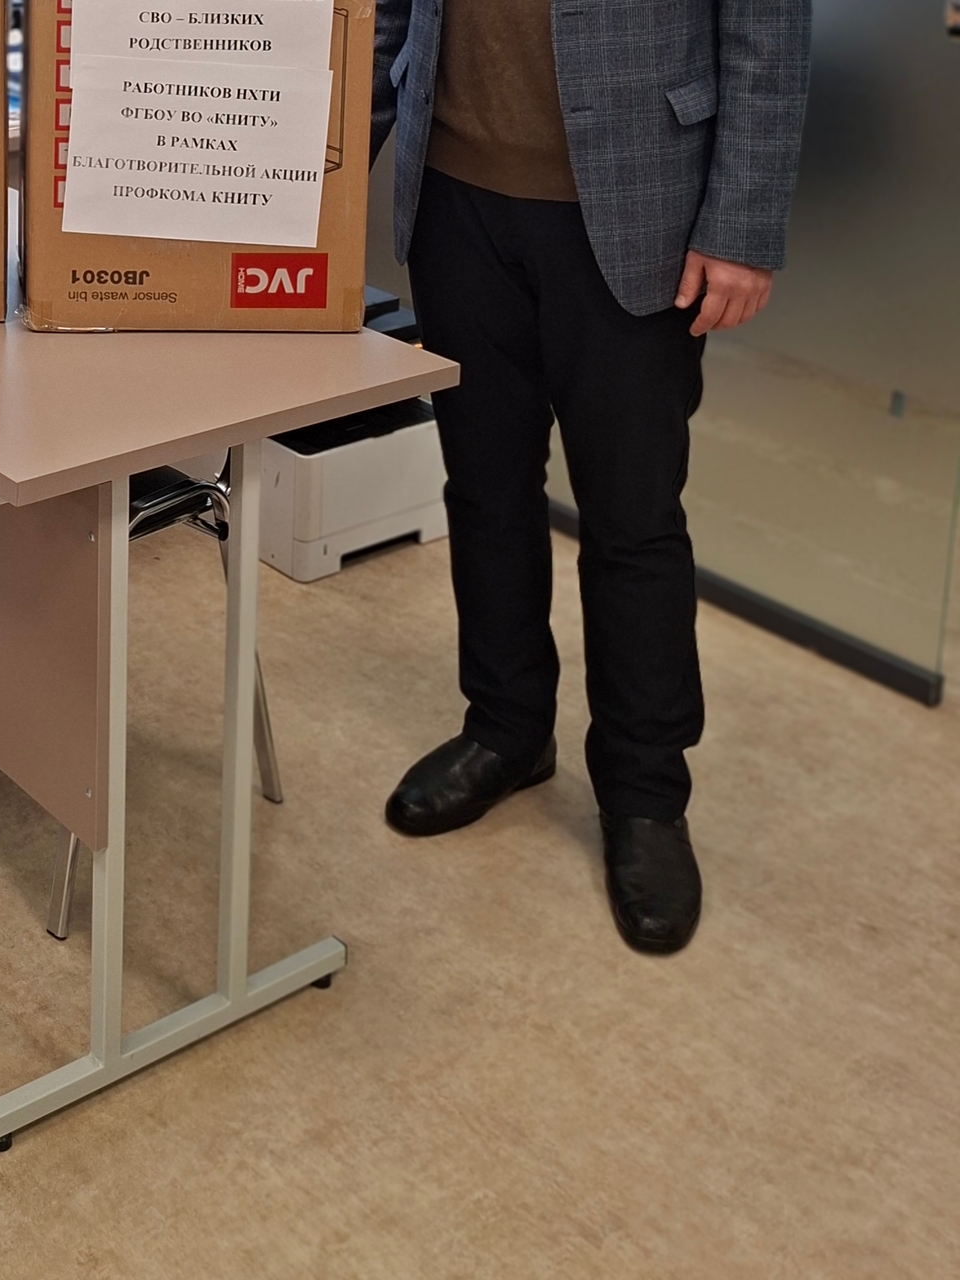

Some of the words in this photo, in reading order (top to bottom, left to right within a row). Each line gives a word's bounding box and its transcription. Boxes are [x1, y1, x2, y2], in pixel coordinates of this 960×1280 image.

[138, 11, 173, 24] СВО
[188, 12, 265, 26] БЛИЗКИХ
[128, 37, 273, 53] РОДСТВЕННИКОВ
[122, 80, 232, 99] РАБОТНИКОВ
[235, 88, 281, 103] НХТИ
[120, 106, 178, 124] ФГБОУ
[181, 110, 203, 124] ВО
[206, 112, 279, 128] «КНИТУ»
[156, 134, 167, 147] В
[170, 136, 239, 152] РАМКАХ
[72, 155, 256, 179] БЛАГОТВОРИТЕЛЬНОЙ
[260, 168, 318, 183] АКЦИИ
[113, 185, 207, 203] ПРОФКОМА
[211, 190, 273, 206] КНИТУ
[71, 269, 150, 285] JB0301
[237, 268, 245, 293] HOME
[245, 268, 313, 294] JVC
[68, 291, 87, 302] bin
[91, 291, 129, 301] waste
[132, 292, 177, 303] Sensor
